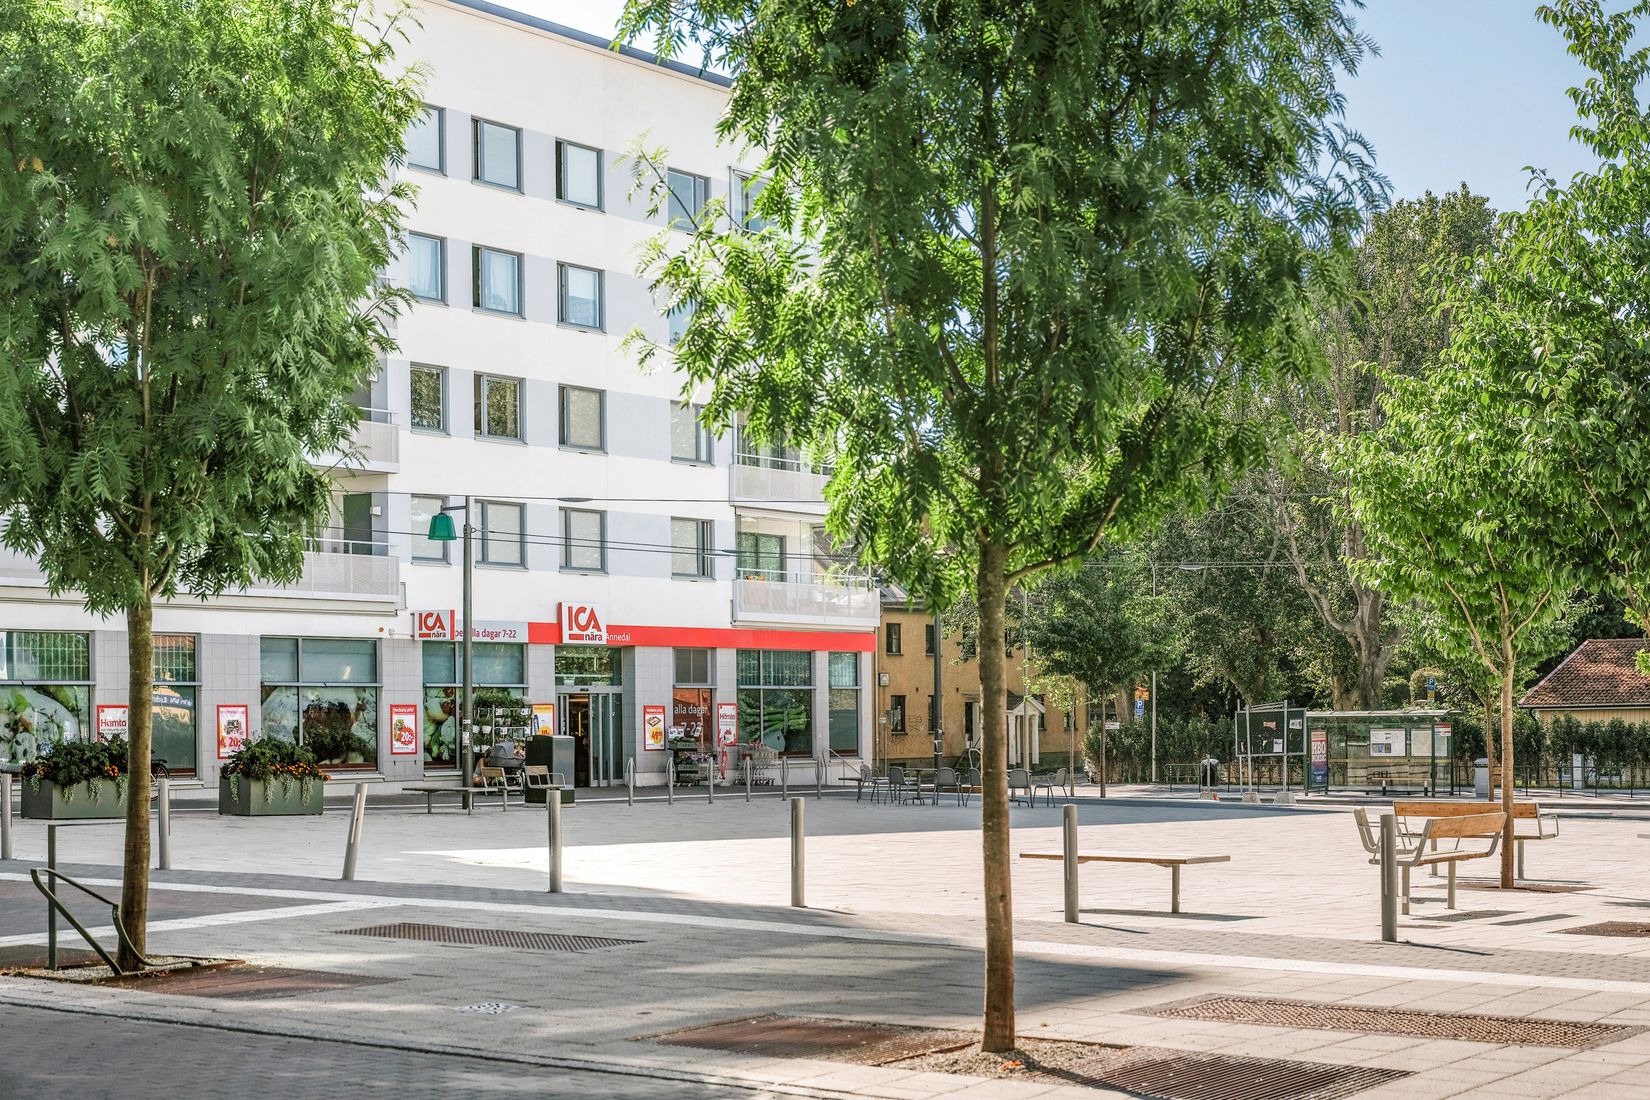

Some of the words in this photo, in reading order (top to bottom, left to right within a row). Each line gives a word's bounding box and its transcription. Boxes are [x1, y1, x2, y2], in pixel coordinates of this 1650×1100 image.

[418, 612, 446, 631] ICA
[568, 606, 602, 632] ICA
[482, 629, 501, 640] dagar
[502, 630, 517, 638] 7-22
[584, 632, 602, 641] nära
[674, 704, 687, 714] alla
[1137, 700, 1143, 709] P
[1312, 741, 1326, 755] HBO
